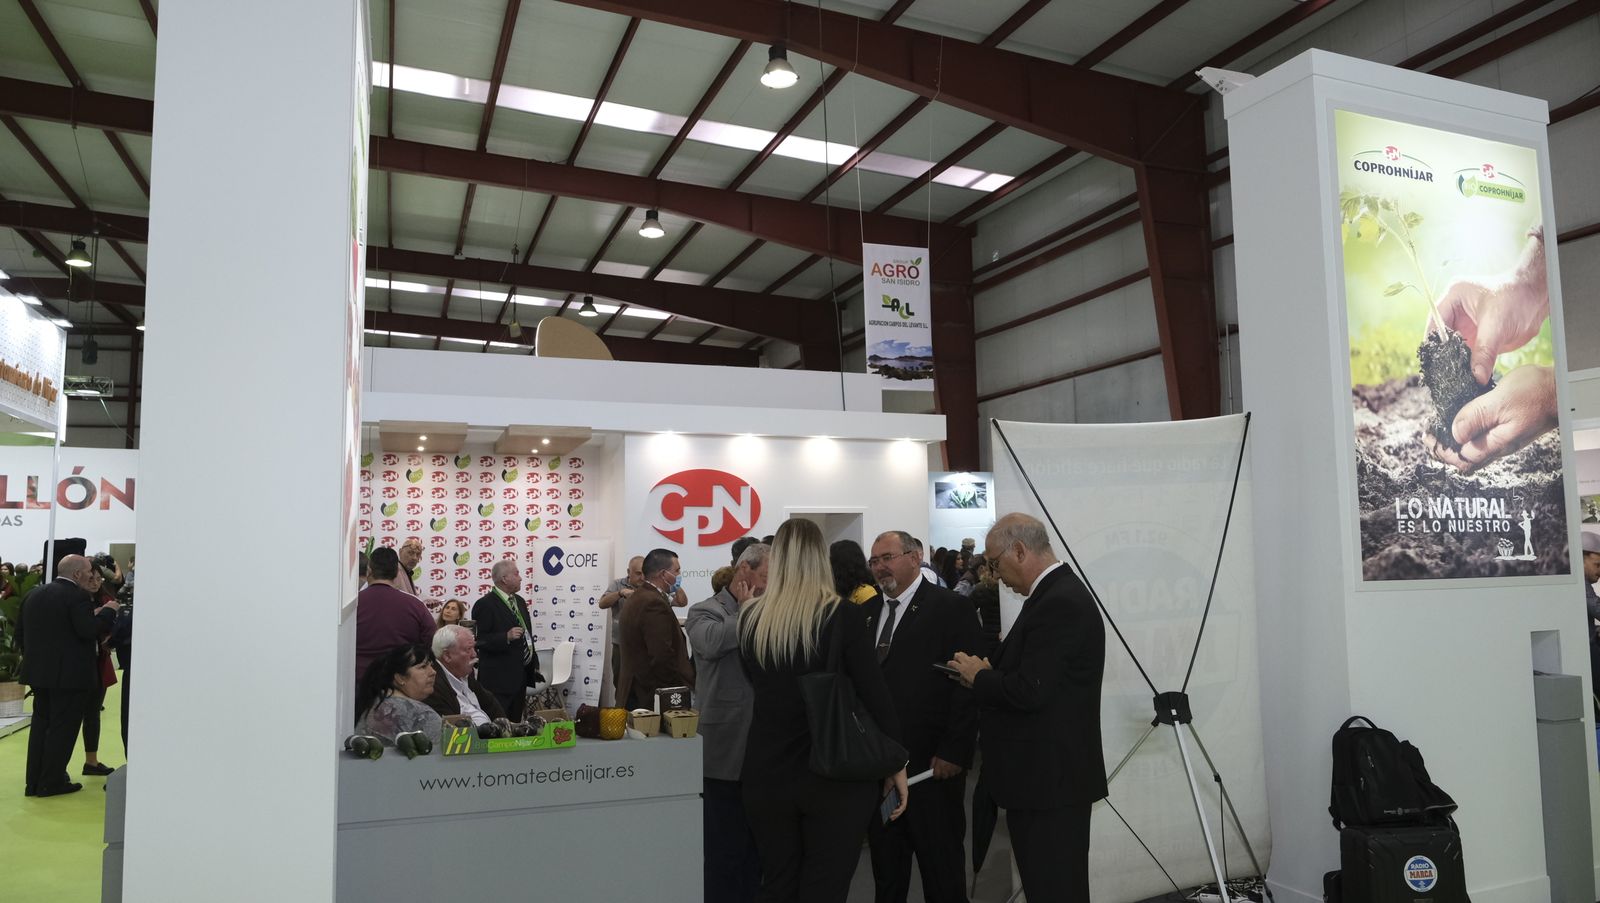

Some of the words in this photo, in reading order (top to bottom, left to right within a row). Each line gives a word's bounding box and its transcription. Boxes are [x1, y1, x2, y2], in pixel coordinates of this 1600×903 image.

[1354, 160, 1434, 182] COPROHNÍJAR
[870, 262, 920, 279] AGRO
[646, 483, 752, 547] CPN
[1396, 497, 1422, 519] LO
[1428, 497, 1512, 519] NATURAL
[0, 515, 23, 526] AS
[1398, 520, 1416, 533] ES
[1422, 520, 1441, 533] LO
[1448, 520, 1510, 533] NUESTRO
[566, 553, 598, 568] COPE
[682, 568, 714, 578] omate
[419, 764, 635, 791] www.tomatedenijar.es
